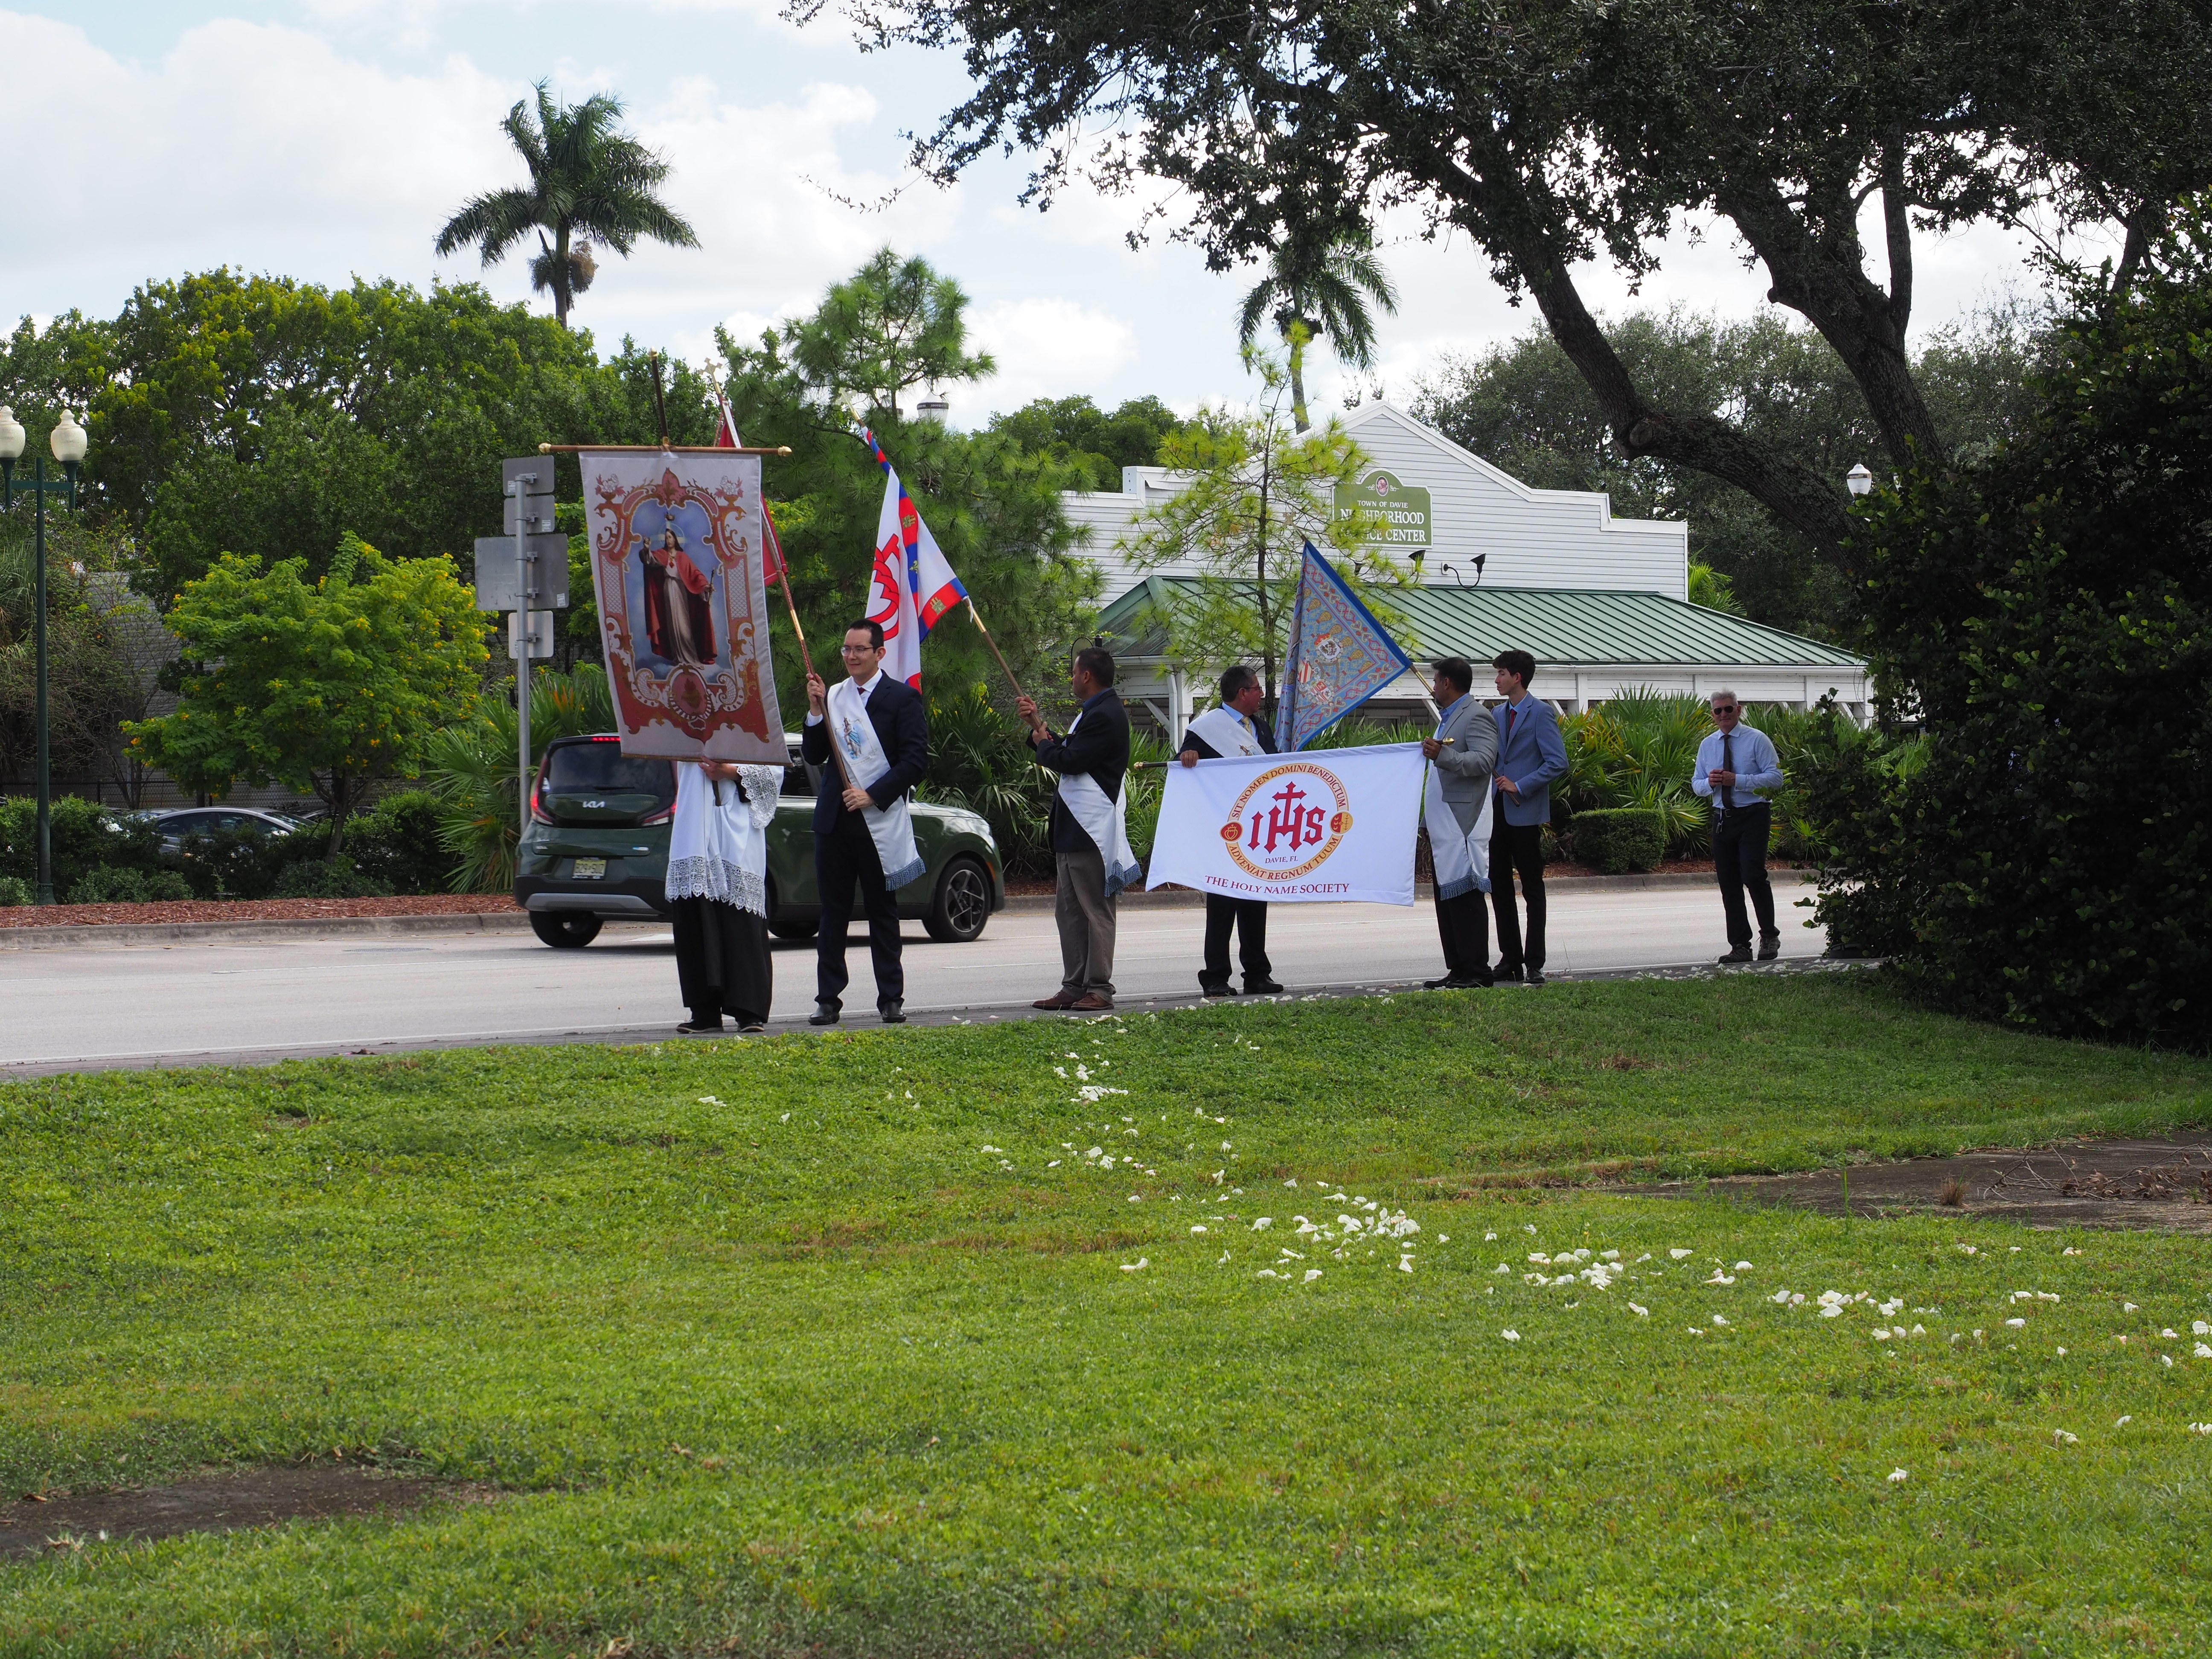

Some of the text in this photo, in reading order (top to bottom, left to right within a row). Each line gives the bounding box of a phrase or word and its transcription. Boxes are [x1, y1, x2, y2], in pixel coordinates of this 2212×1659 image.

[1385, 529, 1426, 542] CENTER
[1231, 765, 1346, 818] SIT NOMEN DOMINI BENEDICTUM
[1248, 781, 1326, 854] IHS
[1229, 836, 1339, 880] ADVENIAT REGNUM TUUM
[1205, 875, 1350, 894] THE HOLY NAME SOCIETY
